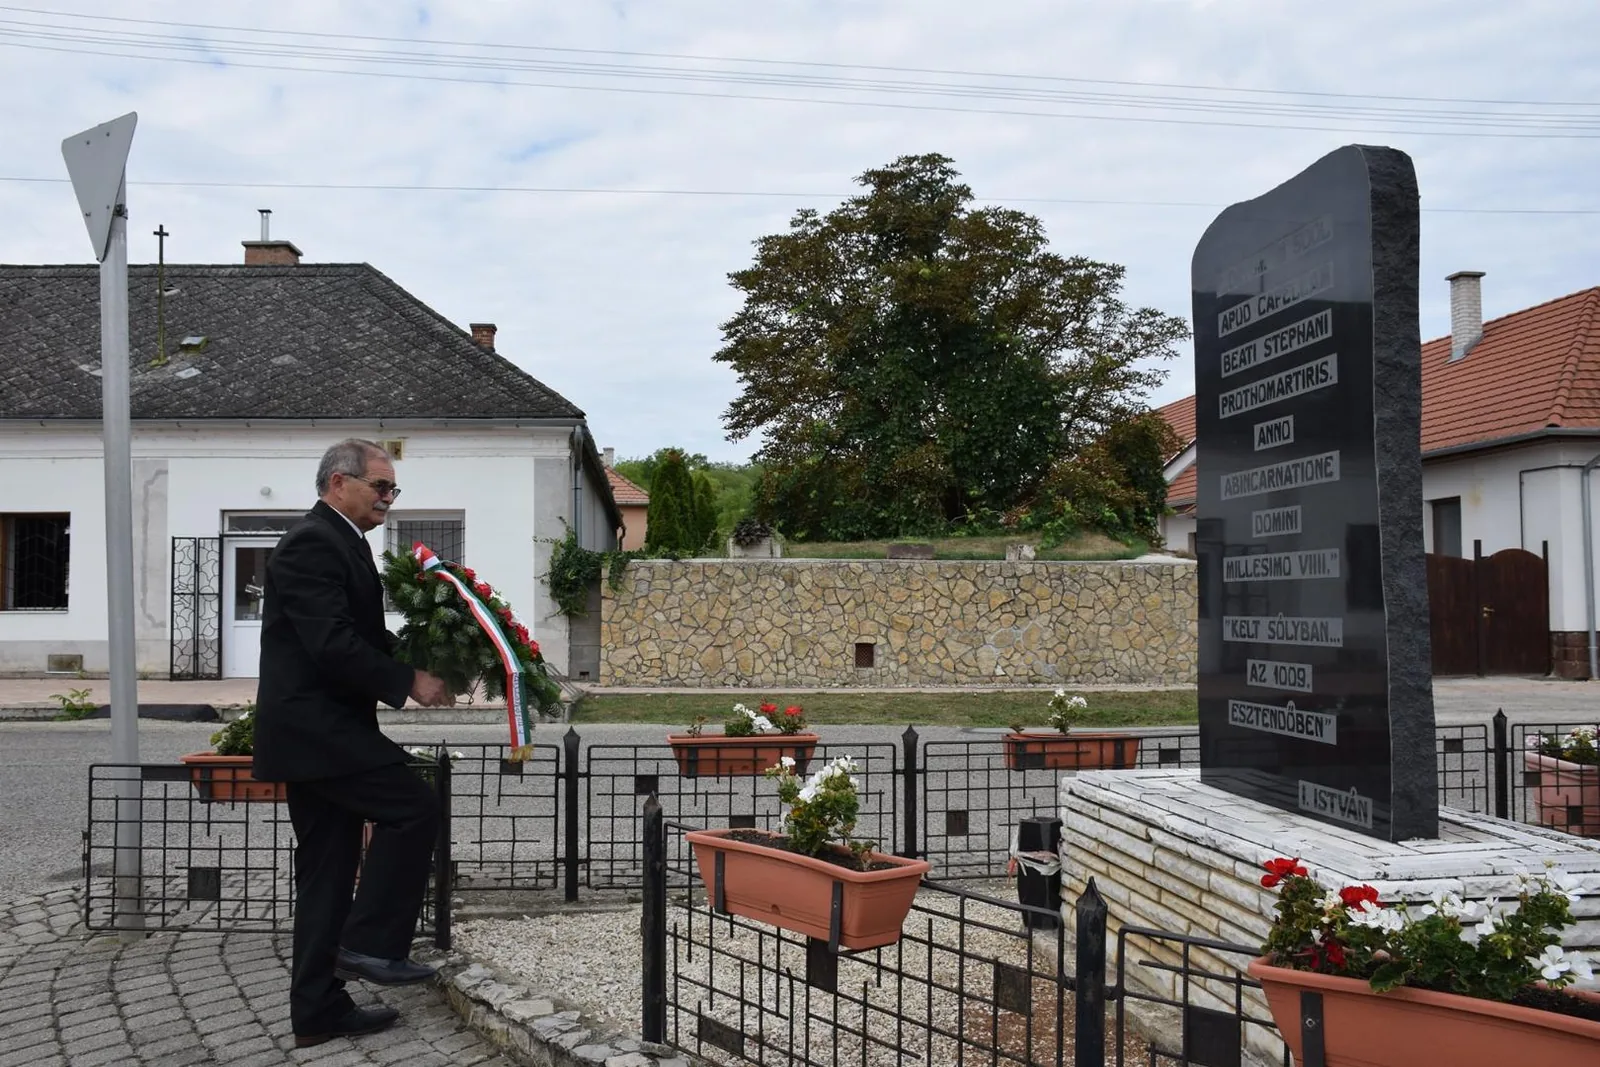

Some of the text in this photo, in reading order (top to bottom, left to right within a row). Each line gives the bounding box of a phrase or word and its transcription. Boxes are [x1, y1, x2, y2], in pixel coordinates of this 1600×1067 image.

[1220, 303, 1251, 334] APUD
[1223, 313, 1329, 373] BEATI STEPHANI
[1221, 360, 1333, 416] PROTHOMARTIRIS.
[1257, 419, 1291, 447] ANNO
[1224, 455, 1334, 497] ABINCARNATIONE
[1255, 509, 1298, 534] DOMINI
[1226, 556, 1292, 579] MILLESIMO
[1267, 615, 1341, 643] SÓLYBAN...
[1250, 664, 1310, 688] AZ 1009.
[1313, 788, 1369, 824] ISTVÁN
